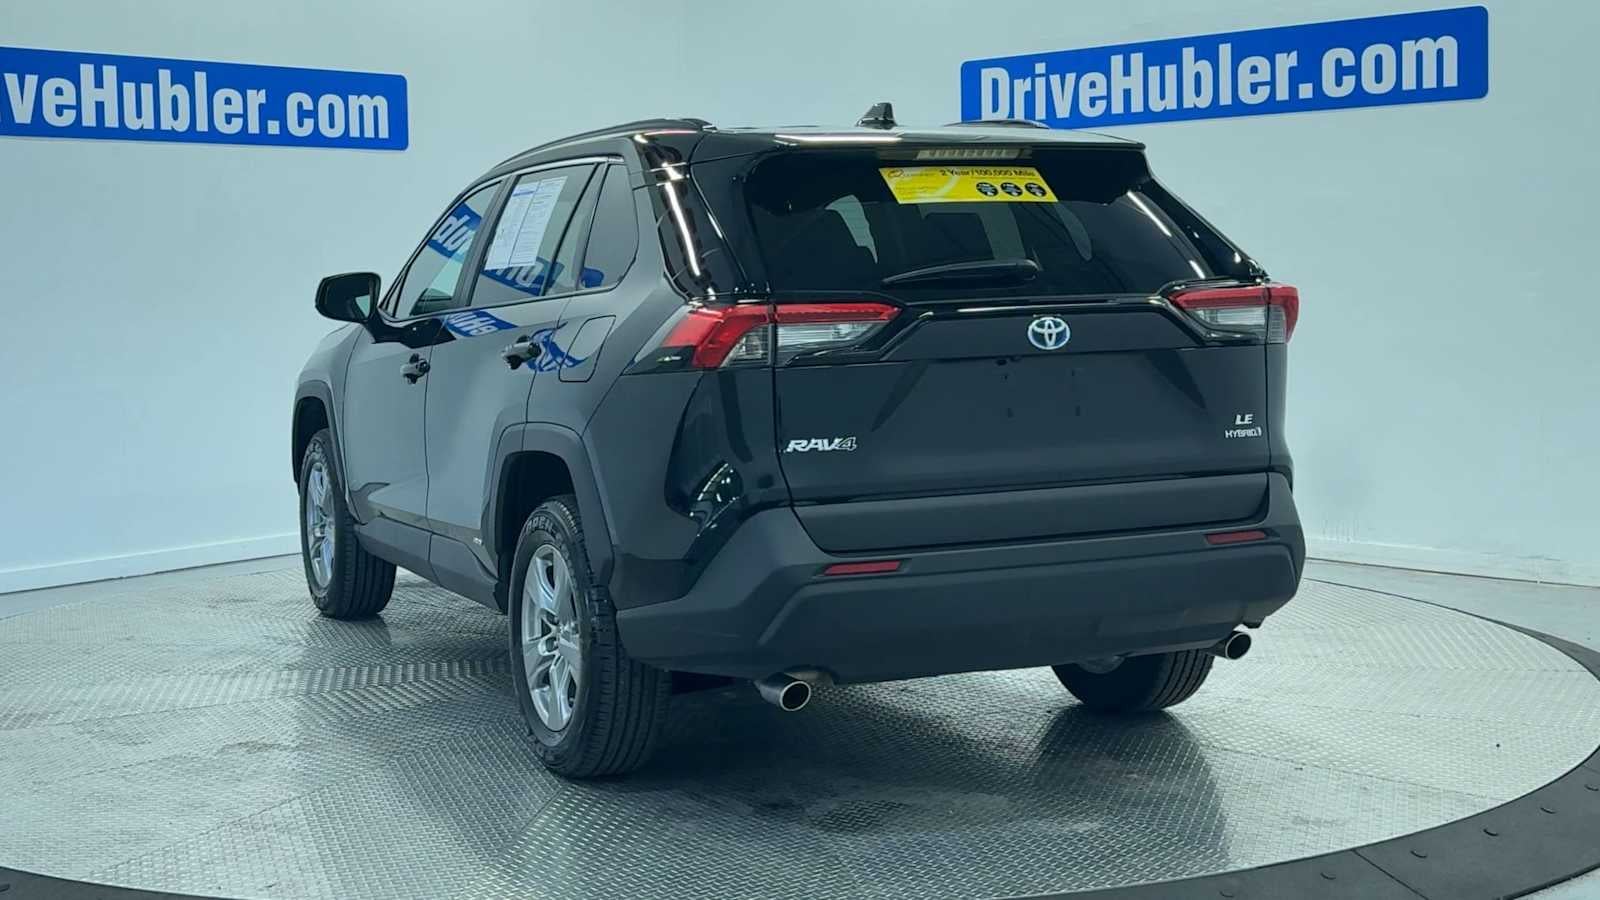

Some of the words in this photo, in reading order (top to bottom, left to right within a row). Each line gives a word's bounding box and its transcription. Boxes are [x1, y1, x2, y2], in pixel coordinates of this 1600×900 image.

[981, 35, 1458, 120] DriveHubler.com
[0, 63, 389, 139] veHubler.com
[1235, 414, 1253, 425] LE
[1225, 427, 1259, 438] HYBRID
[786, 437, 858, 452] RAV4
